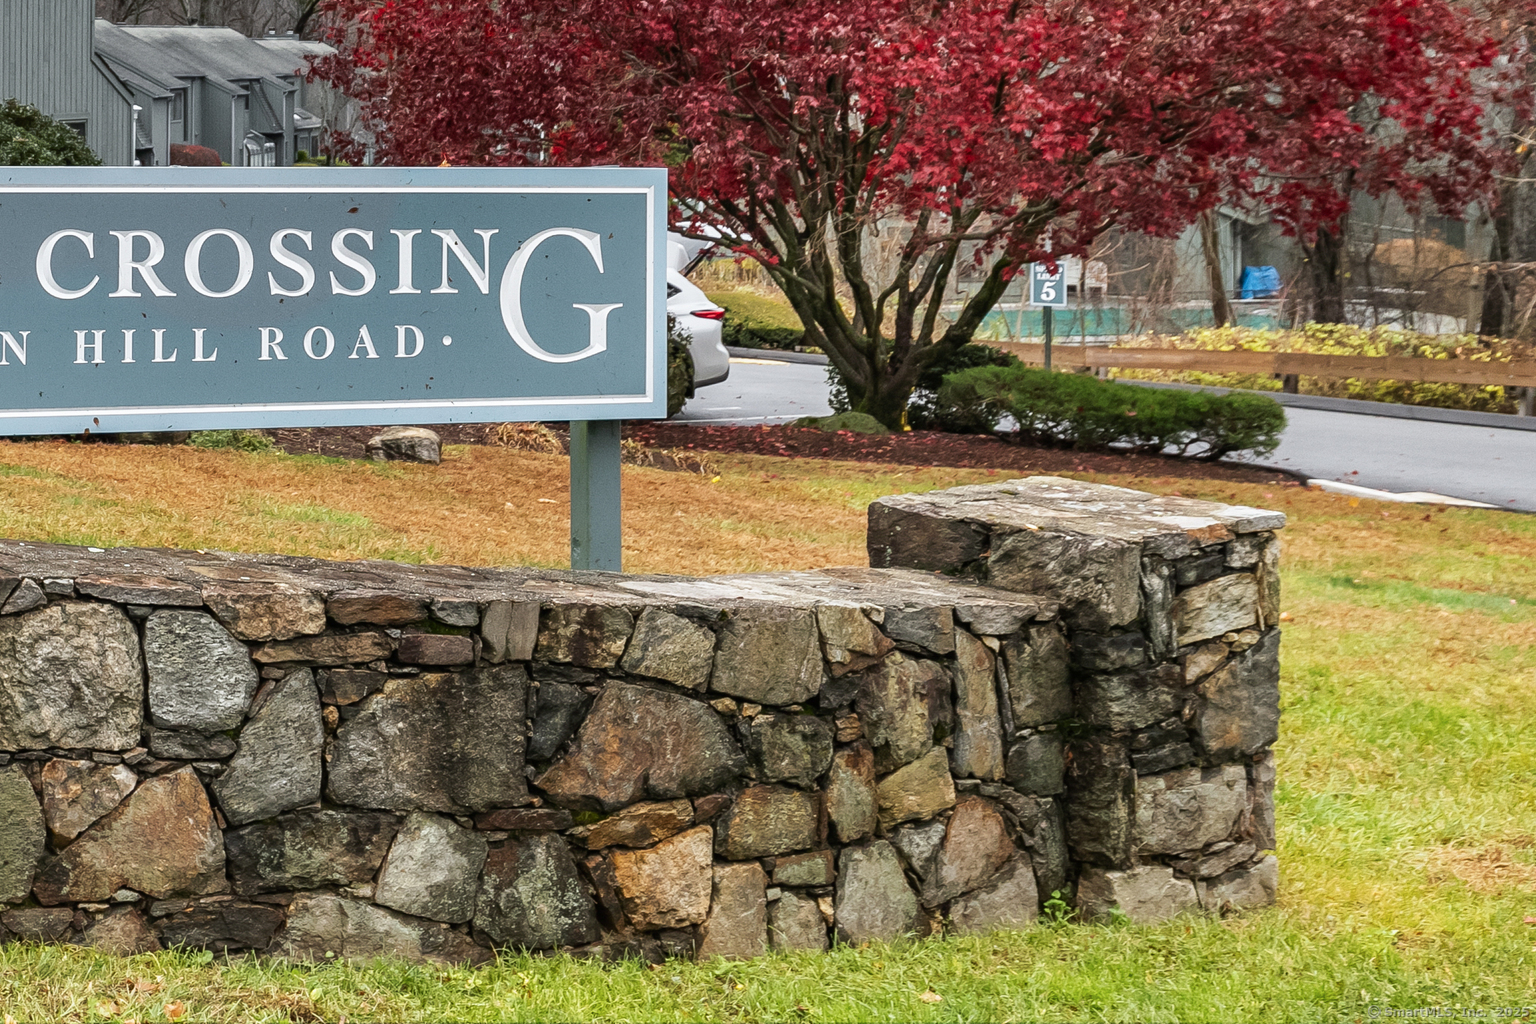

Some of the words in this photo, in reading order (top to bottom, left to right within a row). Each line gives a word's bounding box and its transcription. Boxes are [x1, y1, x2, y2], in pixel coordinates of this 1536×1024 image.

[36, 225, 623, 364] CROSSING
[1040, 281, 1056, 301] 5
[74, 327, 219, 365] HILL
